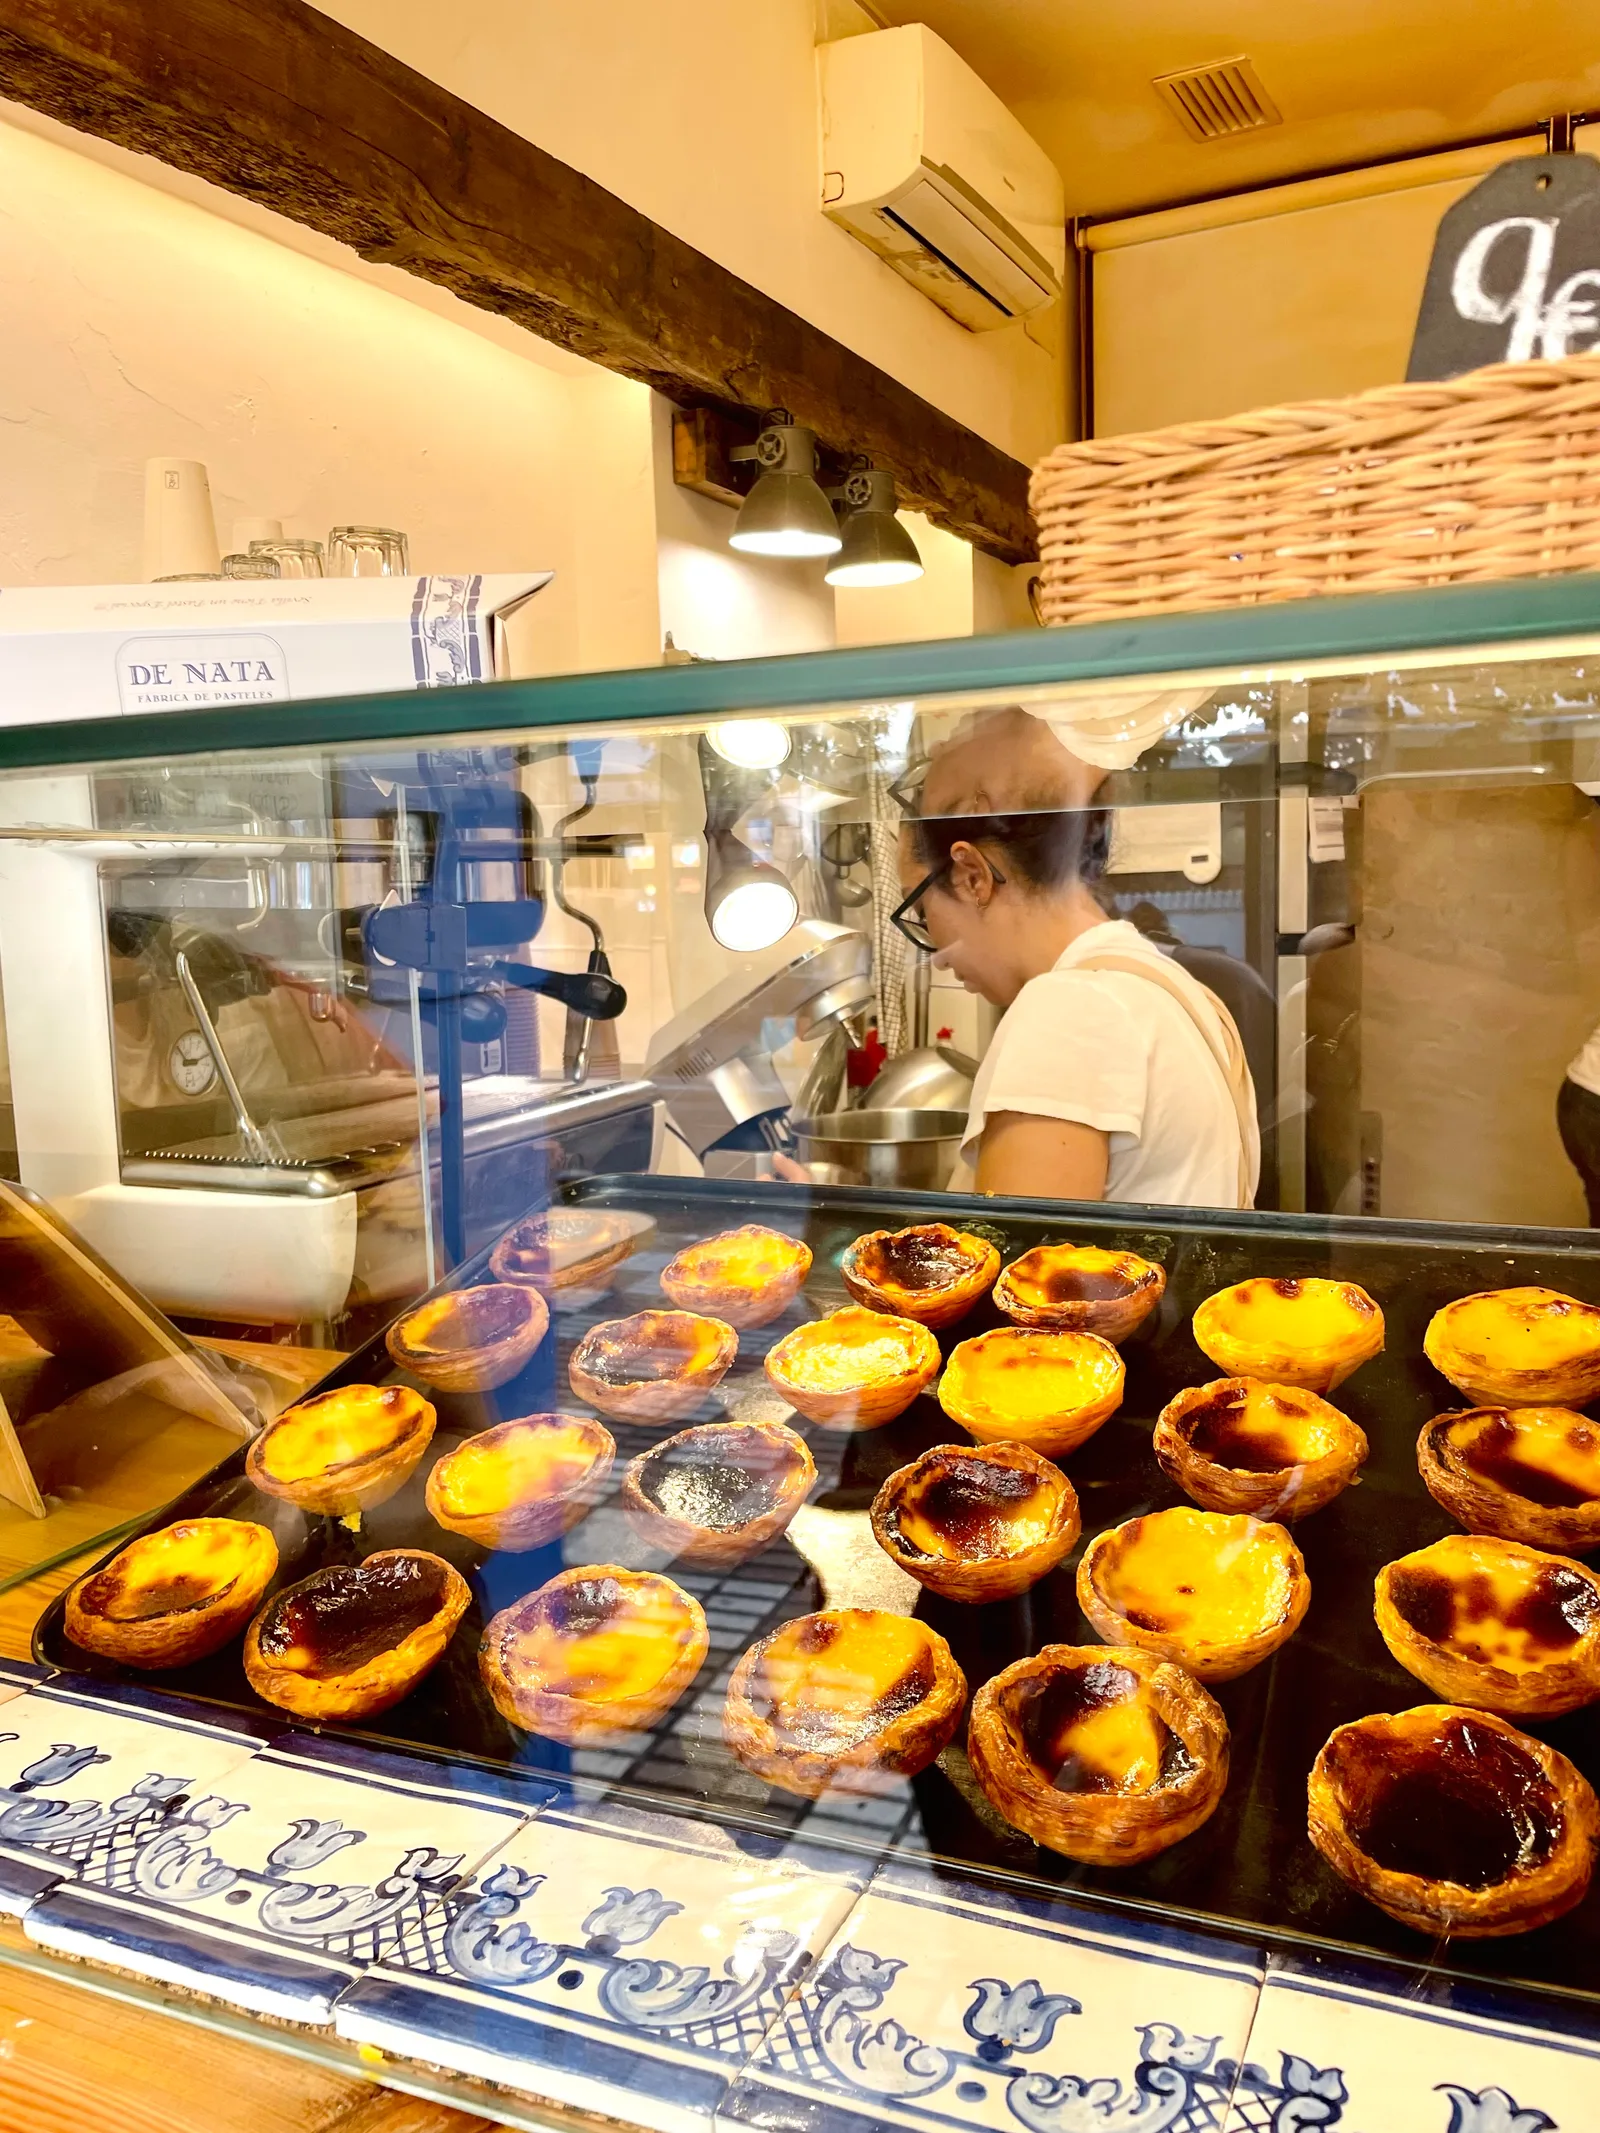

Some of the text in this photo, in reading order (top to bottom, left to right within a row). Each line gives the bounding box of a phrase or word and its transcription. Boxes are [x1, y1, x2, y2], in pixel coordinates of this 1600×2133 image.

[128, 660, 276, 686] DE NATA
[193, 691, 210, 702] DE
[214, 690, 274, 700] PASTELES
